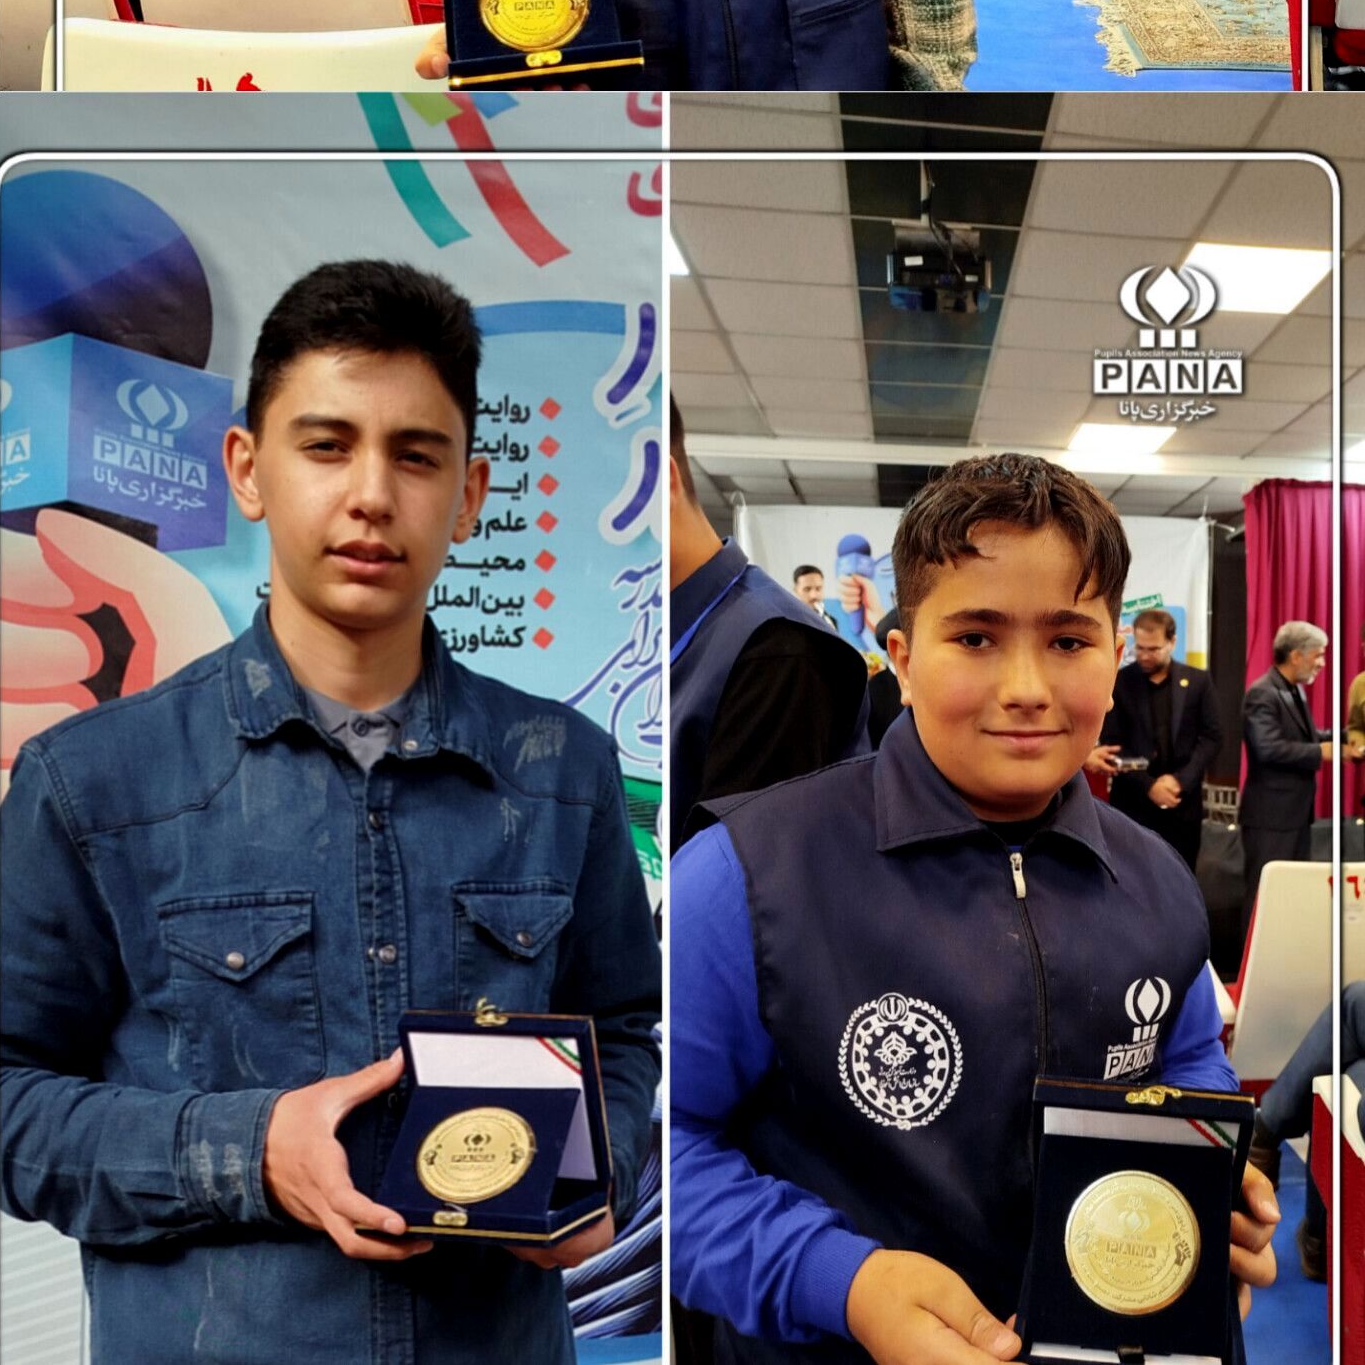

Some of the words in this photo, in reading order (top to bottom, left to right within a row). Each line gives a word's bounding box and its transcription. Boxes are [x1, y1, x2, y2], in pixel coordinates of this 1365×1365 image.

[95, 436, 206, 489] PANA
[94, 465, 119, 494] پانا
[119, 480, 207, 511] خبرگزاری
[485, 510, 528, 540] علم
[1106, 1046, 1155, 1078] PAN
[1107, 1241, 1157, 1259] PANA
